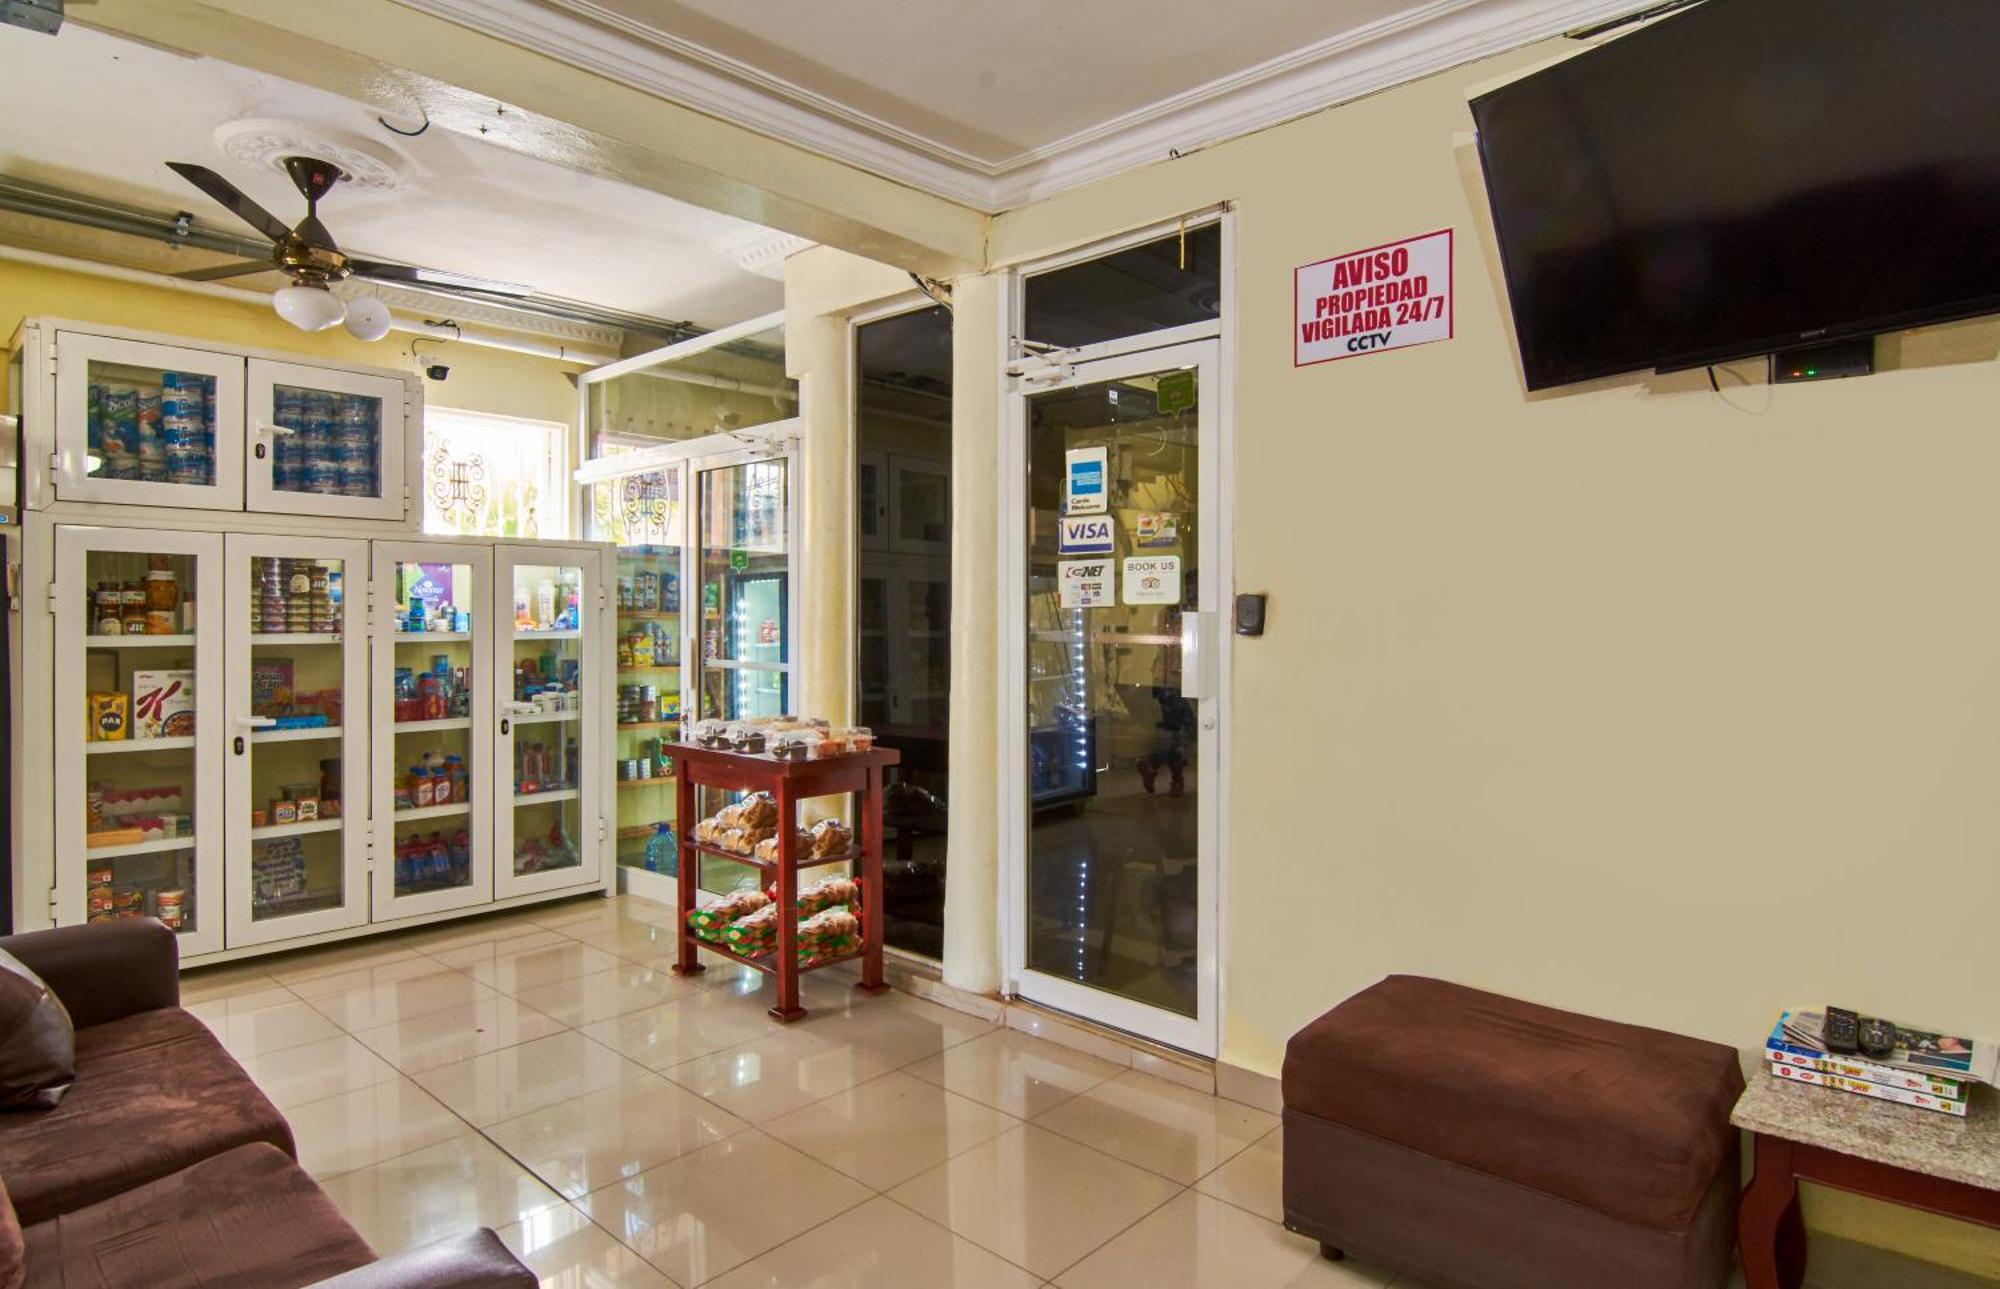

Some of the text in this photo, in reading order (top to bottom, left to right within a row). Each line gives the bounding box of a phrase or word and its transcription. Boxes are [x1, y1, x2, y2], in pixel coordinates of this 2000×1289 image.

[1333, 247, 1409, 290] AVISO
[1316, 275, 1428, 318] PROPIEDAD
[1302, 295, 1444, 343] VIGILADA 24/7
[1347, 331, 1392, 352] CCTV
[1068, 523, 1110, 539] VISA
[1127, 561, 1175, 572] BOOK US
